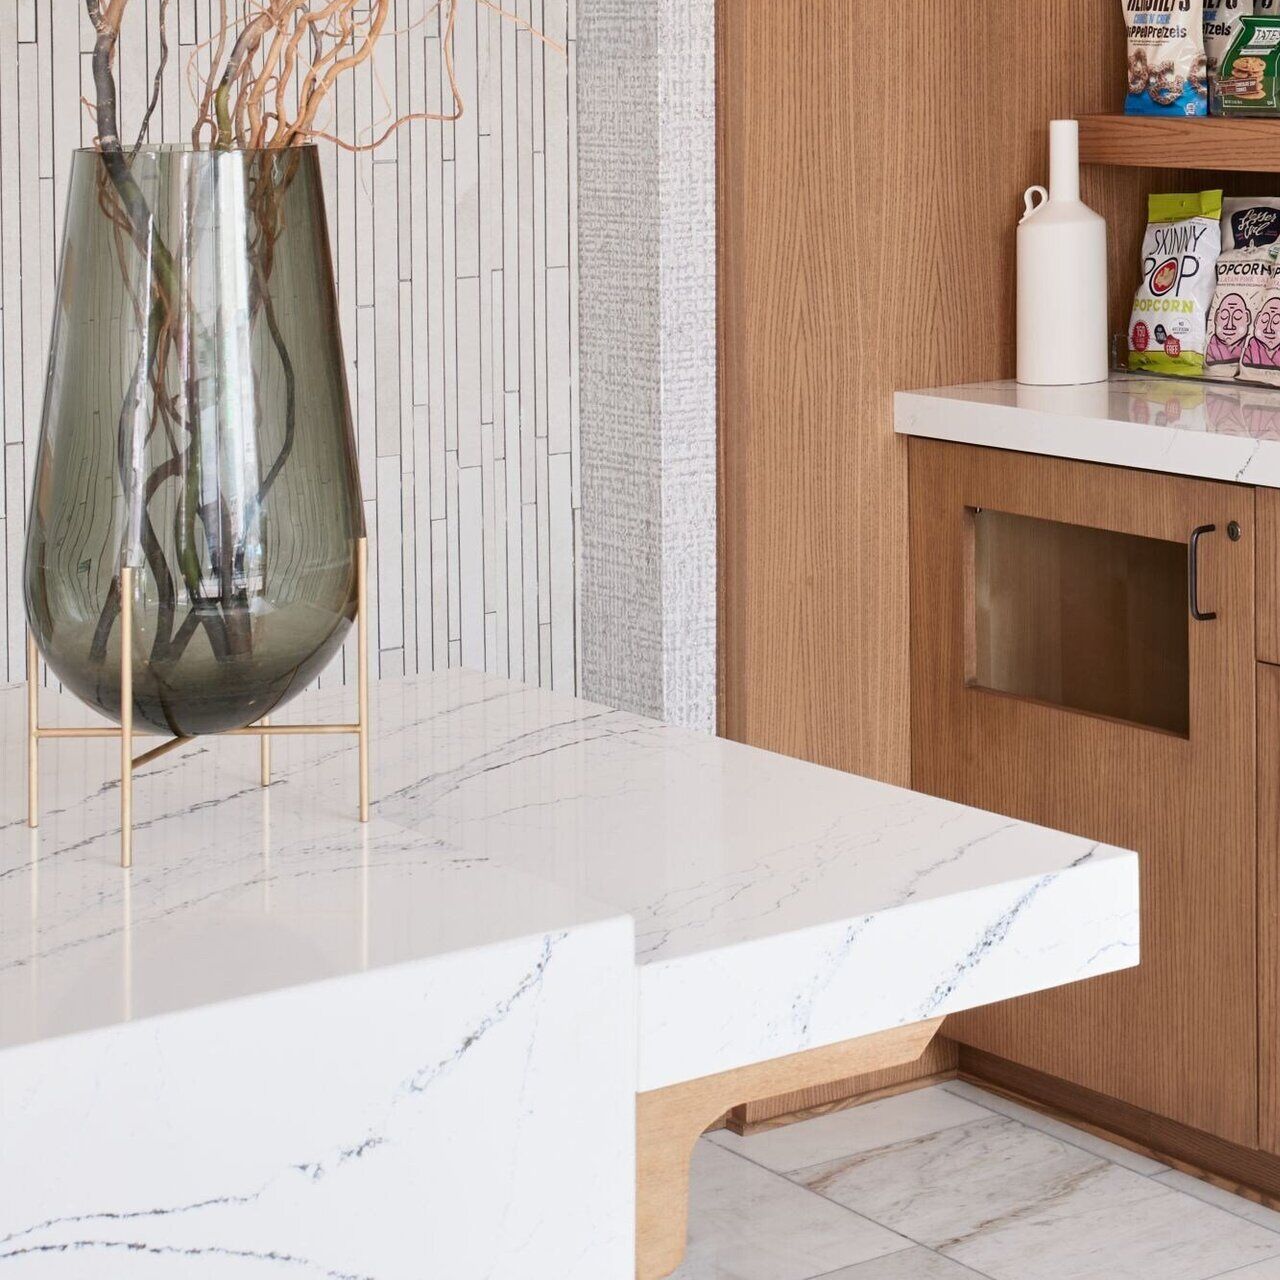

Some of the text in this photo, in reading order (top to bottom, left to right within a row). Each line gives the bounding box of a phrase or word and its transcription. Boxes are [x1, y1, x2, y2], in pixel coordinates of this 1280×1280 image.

[1149, 226, 1208, 256] SKINNY
[1145, 256, 1200, 297] POP
[1134, 298, 1196, 313] POPCORN
